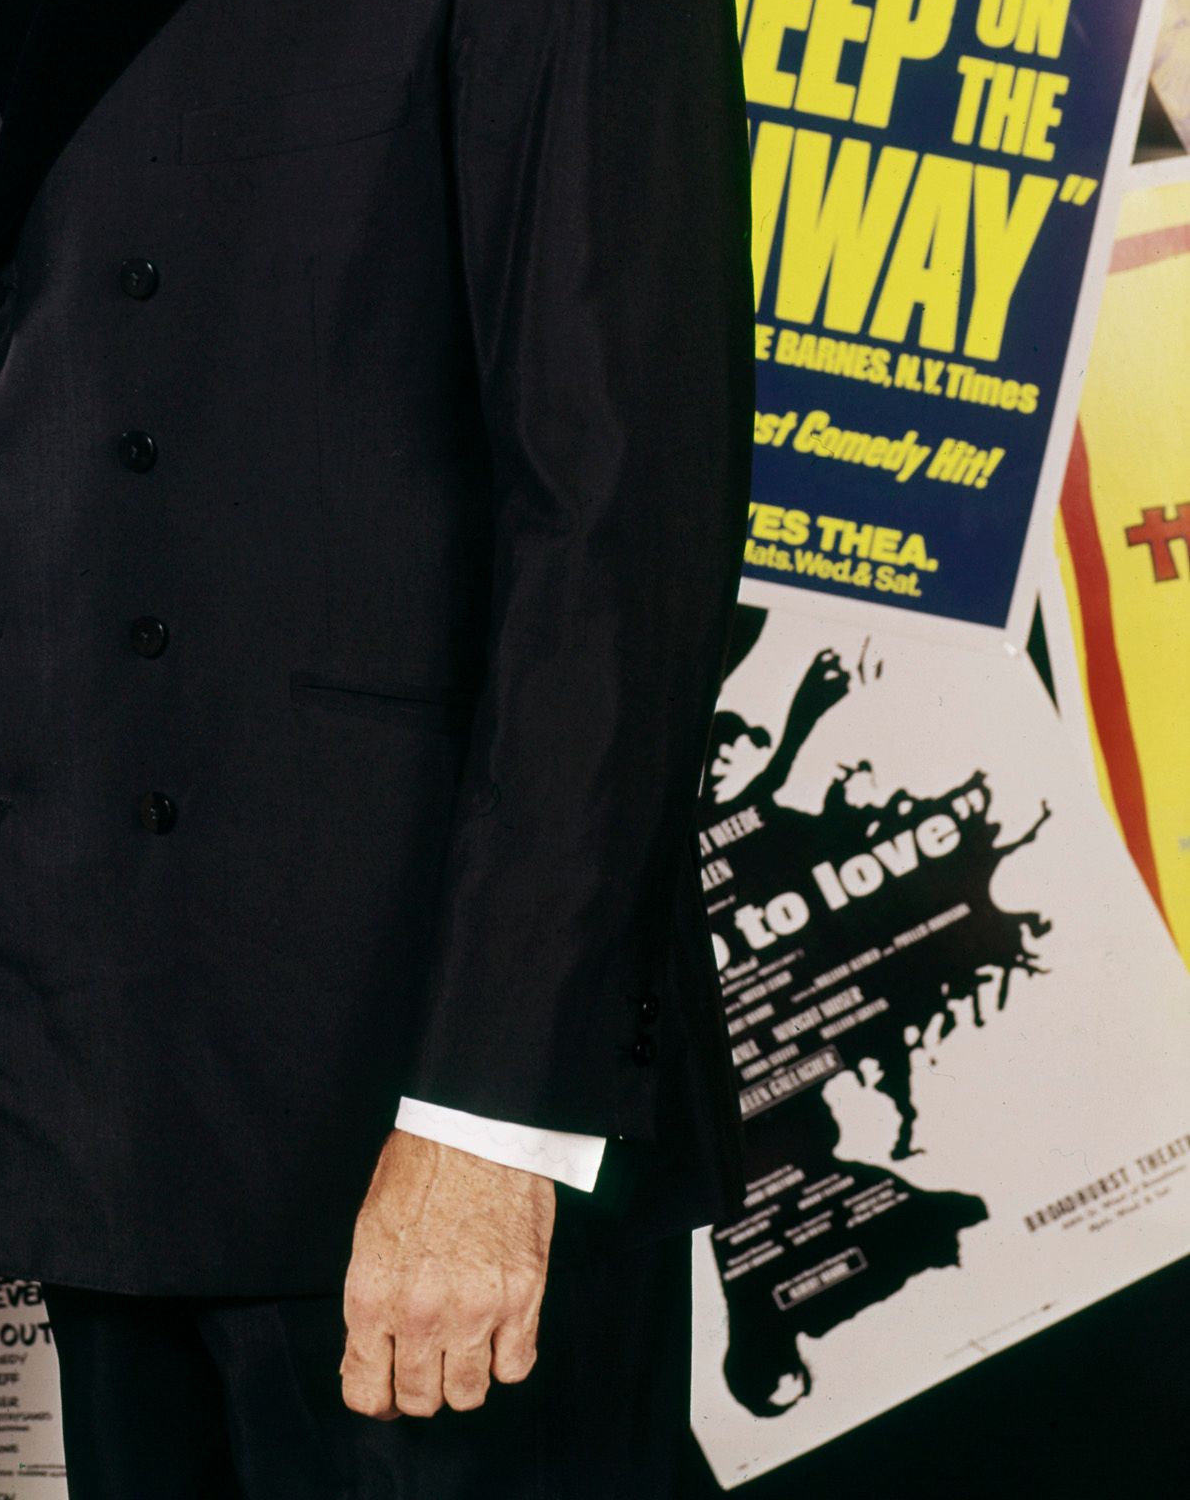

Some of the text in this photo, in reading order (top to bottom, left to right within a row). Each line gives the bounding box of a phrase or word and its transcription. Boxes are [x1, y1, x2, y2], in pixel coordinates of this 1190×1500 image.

[951, 55, 1070, 162] THE
[774, 328, 893, 388] BARNES,
[792, 409, 1006, 490] Comedy Hit!
[816, 515, 939, 573] THEA.
[734, 891, 811, 951] to
